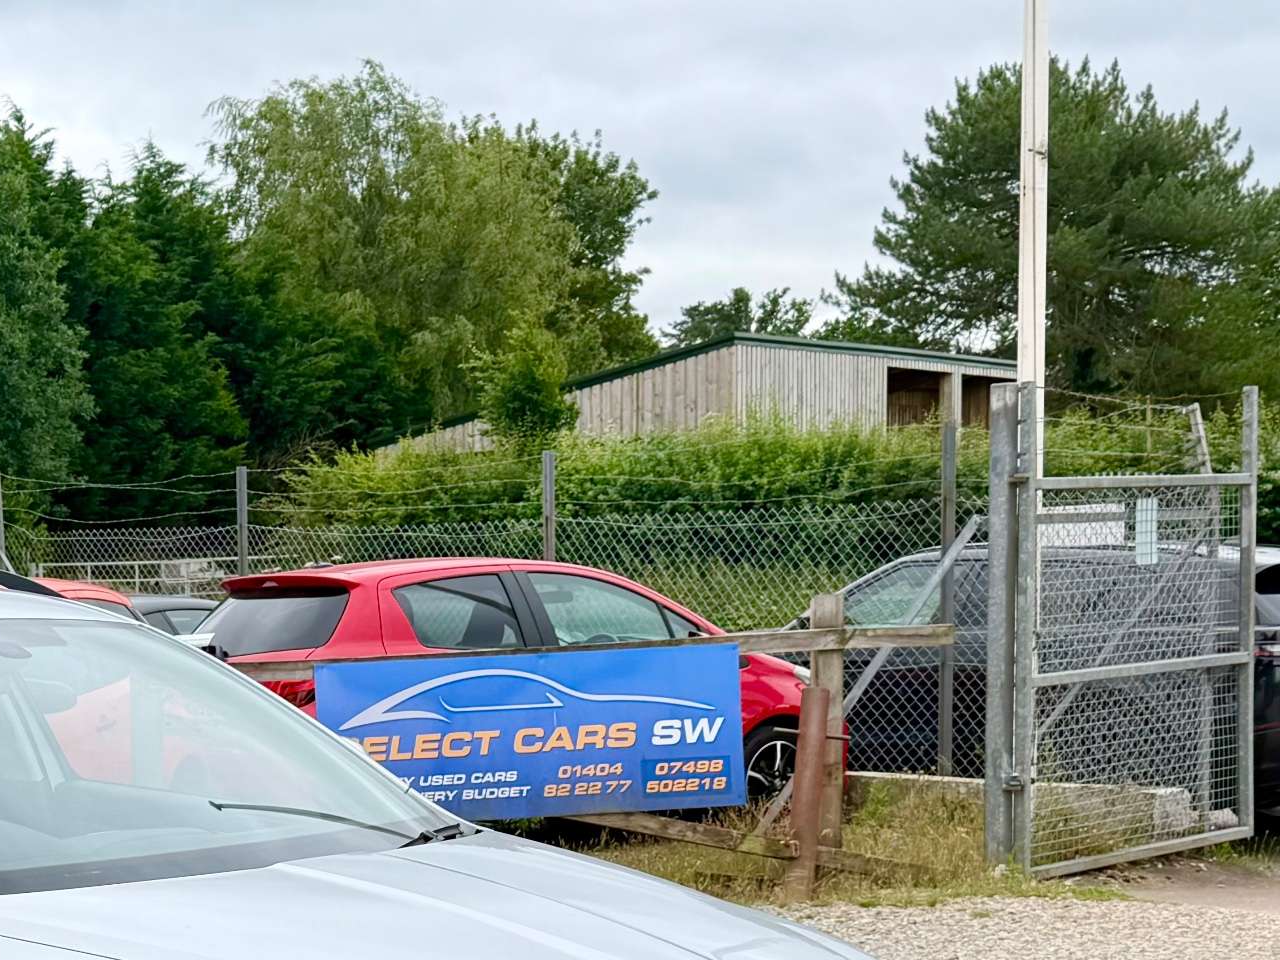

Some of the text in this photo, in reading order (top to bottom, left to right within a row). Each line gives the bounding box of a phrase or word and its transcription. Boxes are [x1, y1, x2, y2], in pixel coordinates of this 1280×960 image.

[346, 717, 725, 762] ELECT CARS SW
[558, 760, 724, 779] 01404 07498
[420, 774, 466, 786] USED
[471, 771, 518, 784] CARS
[646, 777, 728, 793] 502218
[463, 786, 531, 801] BUDGET
